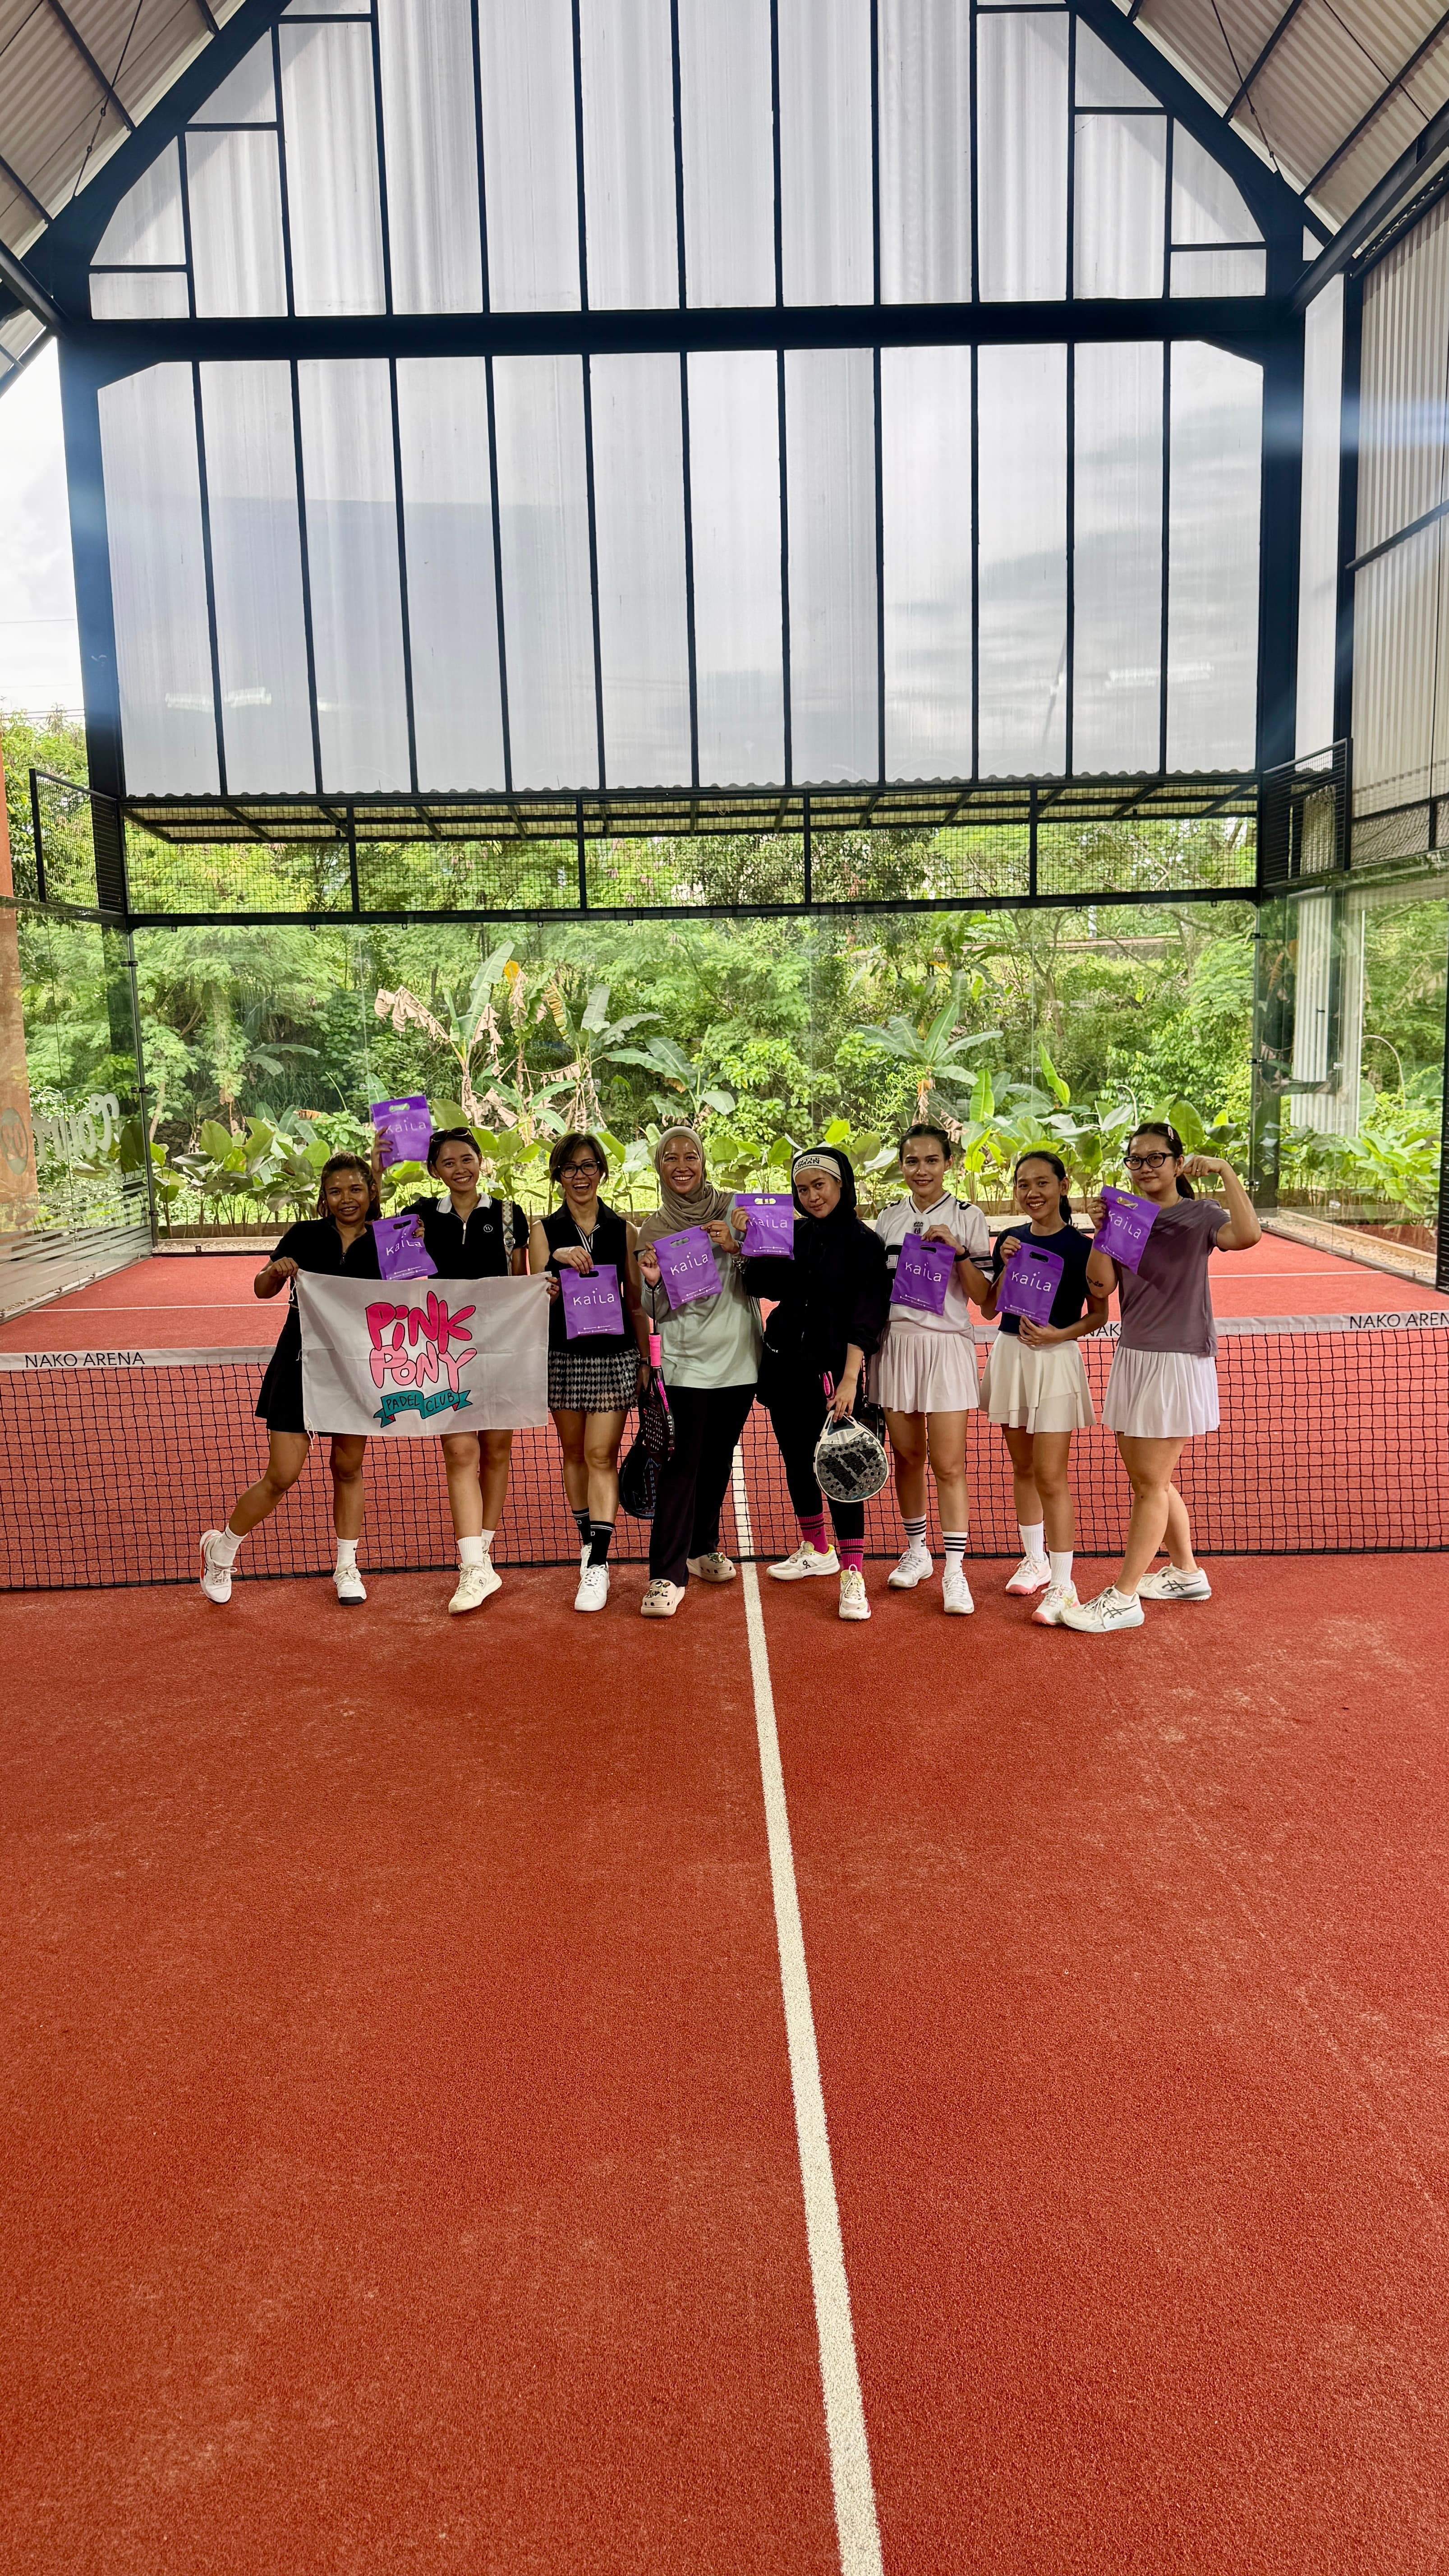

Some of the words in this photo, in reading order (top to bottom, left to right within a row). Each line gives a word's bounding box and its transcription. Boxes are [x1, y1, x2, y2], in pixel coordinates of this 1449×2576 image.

[794, 1159, 820, 1170] OMAN
[1350, 1314, 1400, 1329] NAKO
[1083, 1323, 1122, 1337] AK
[25, 1353, 78, 1367] NAKO
[83, 1352, 145, 1366] ARENA
[386, 1394, 420, 1411] PADEL
[426, 1392, 455, 1412] CLUB
